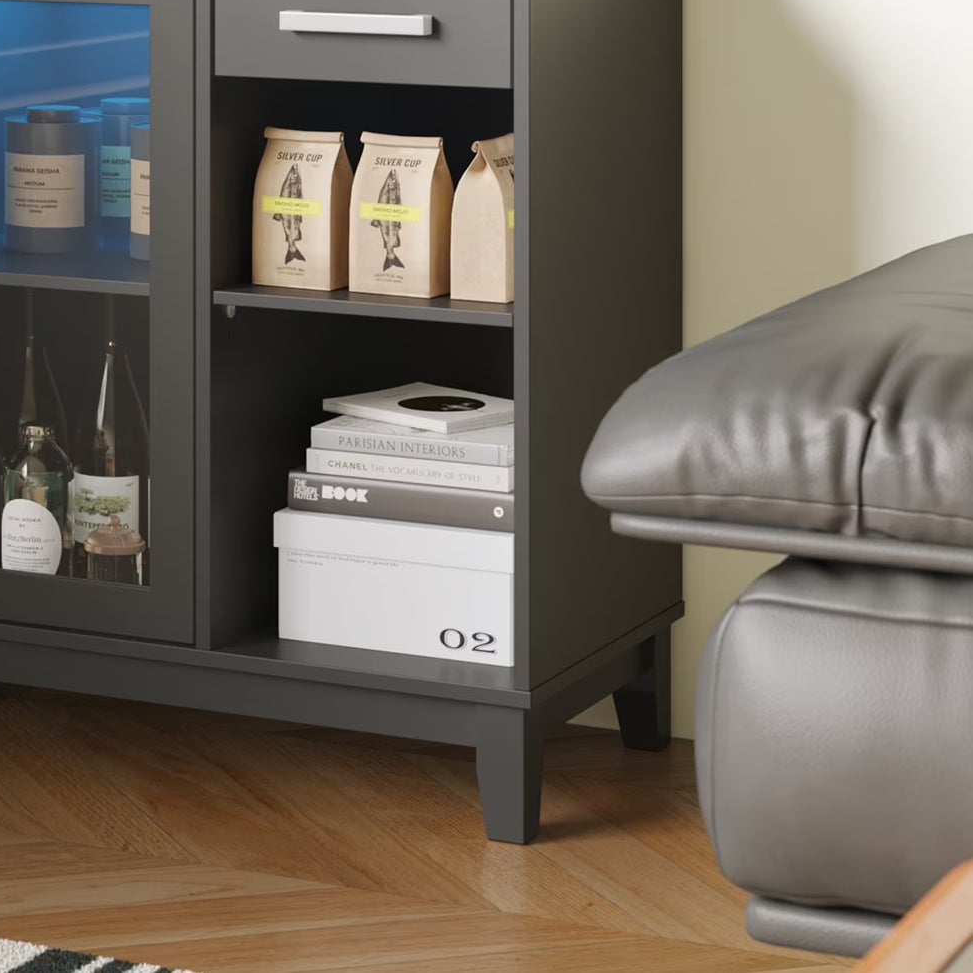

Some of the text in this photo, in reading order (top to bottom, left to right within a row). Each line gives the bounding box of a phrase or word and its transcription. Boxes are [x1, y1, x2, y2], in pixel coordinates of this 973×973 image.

[276, 151, 323, 163] SILVER CUP
[374, 156, 422, 168] SILVER CUP
[36, 167, 60, 175] GEISHA
[338, 435, 466, 458] PARISIAN INTERIORS
[327, 459, 368, 471] CHANEL
[371, 464, 386, 473] THE
[294, 478, 307, 486] THE
[321, 484, 369, 503] BOOK
[439, 628, 495, 654] 02
